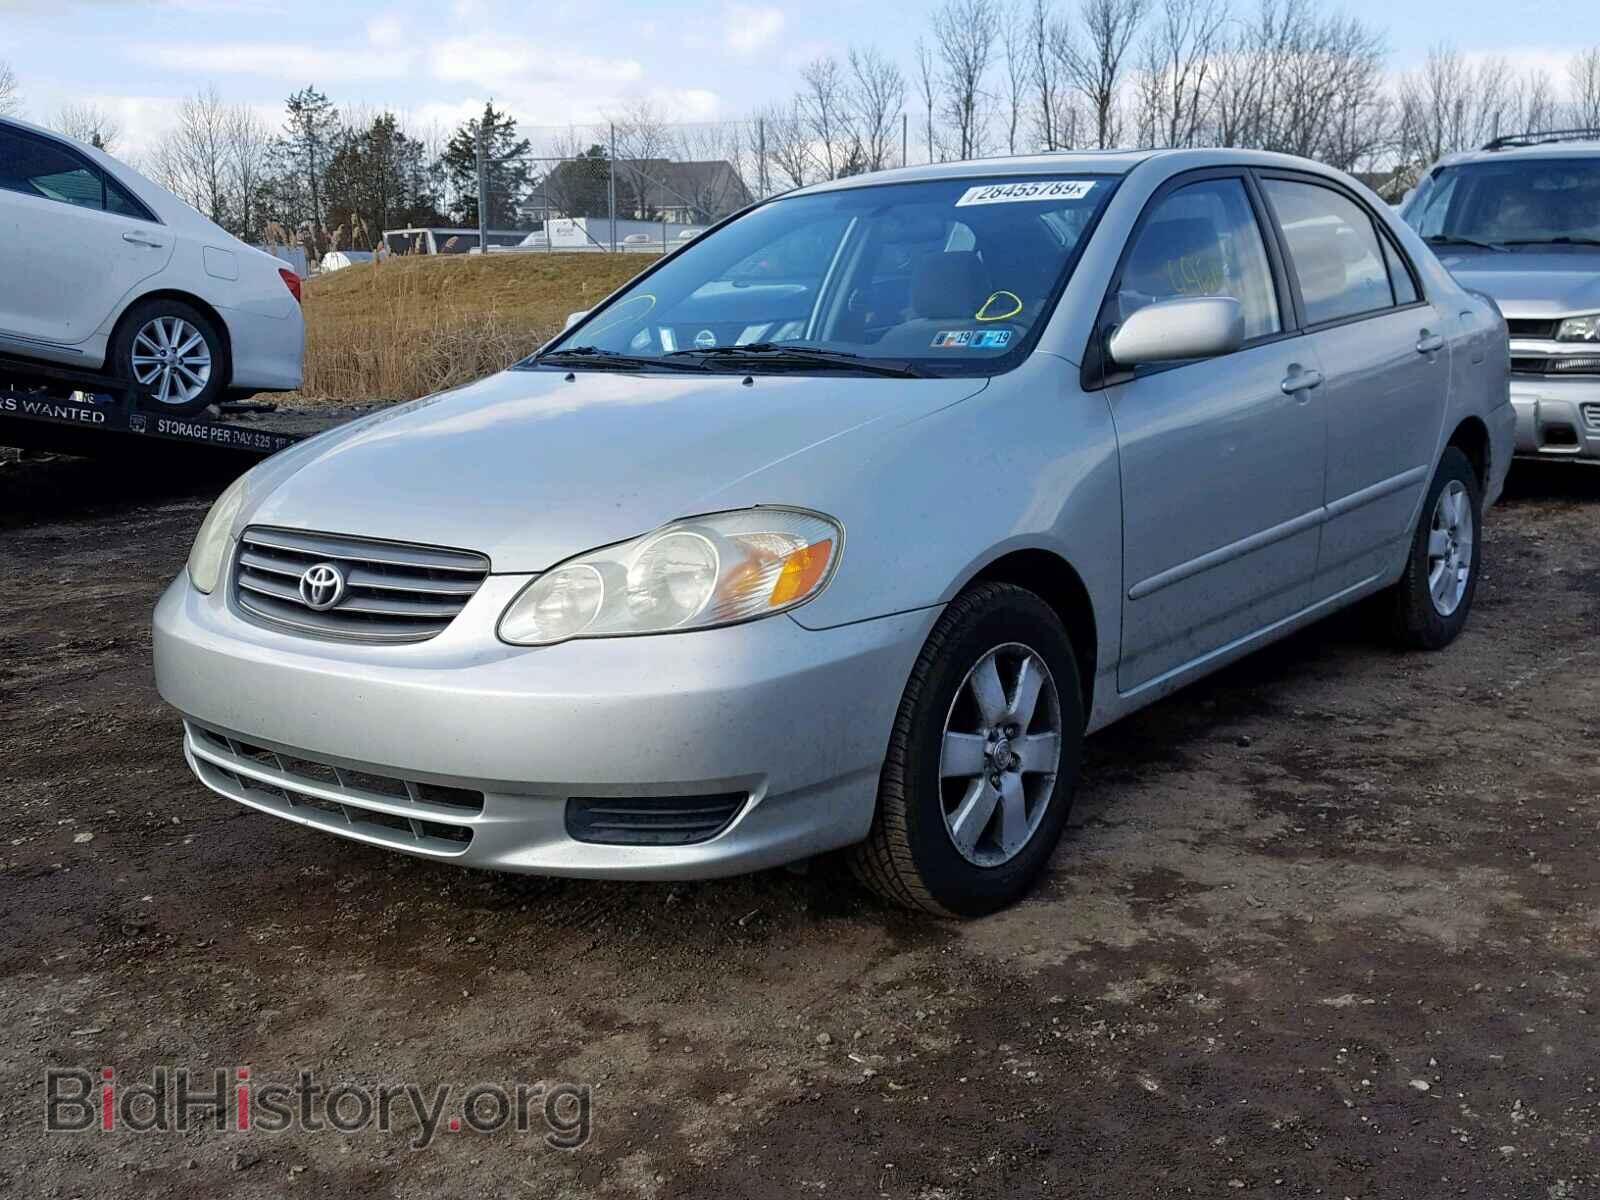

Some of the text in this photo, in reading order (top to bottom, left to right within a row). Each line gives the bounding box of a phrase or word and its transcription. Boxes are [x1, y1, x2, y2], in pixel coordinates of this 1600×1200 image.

[22, 400, 105, 423] WANTED
[158, 419, 208, 439] STORAGE
[210, 427, 231, 443] PER
[232, 431, 251, 446] DAY
[254, 433, 271, 448] $25
